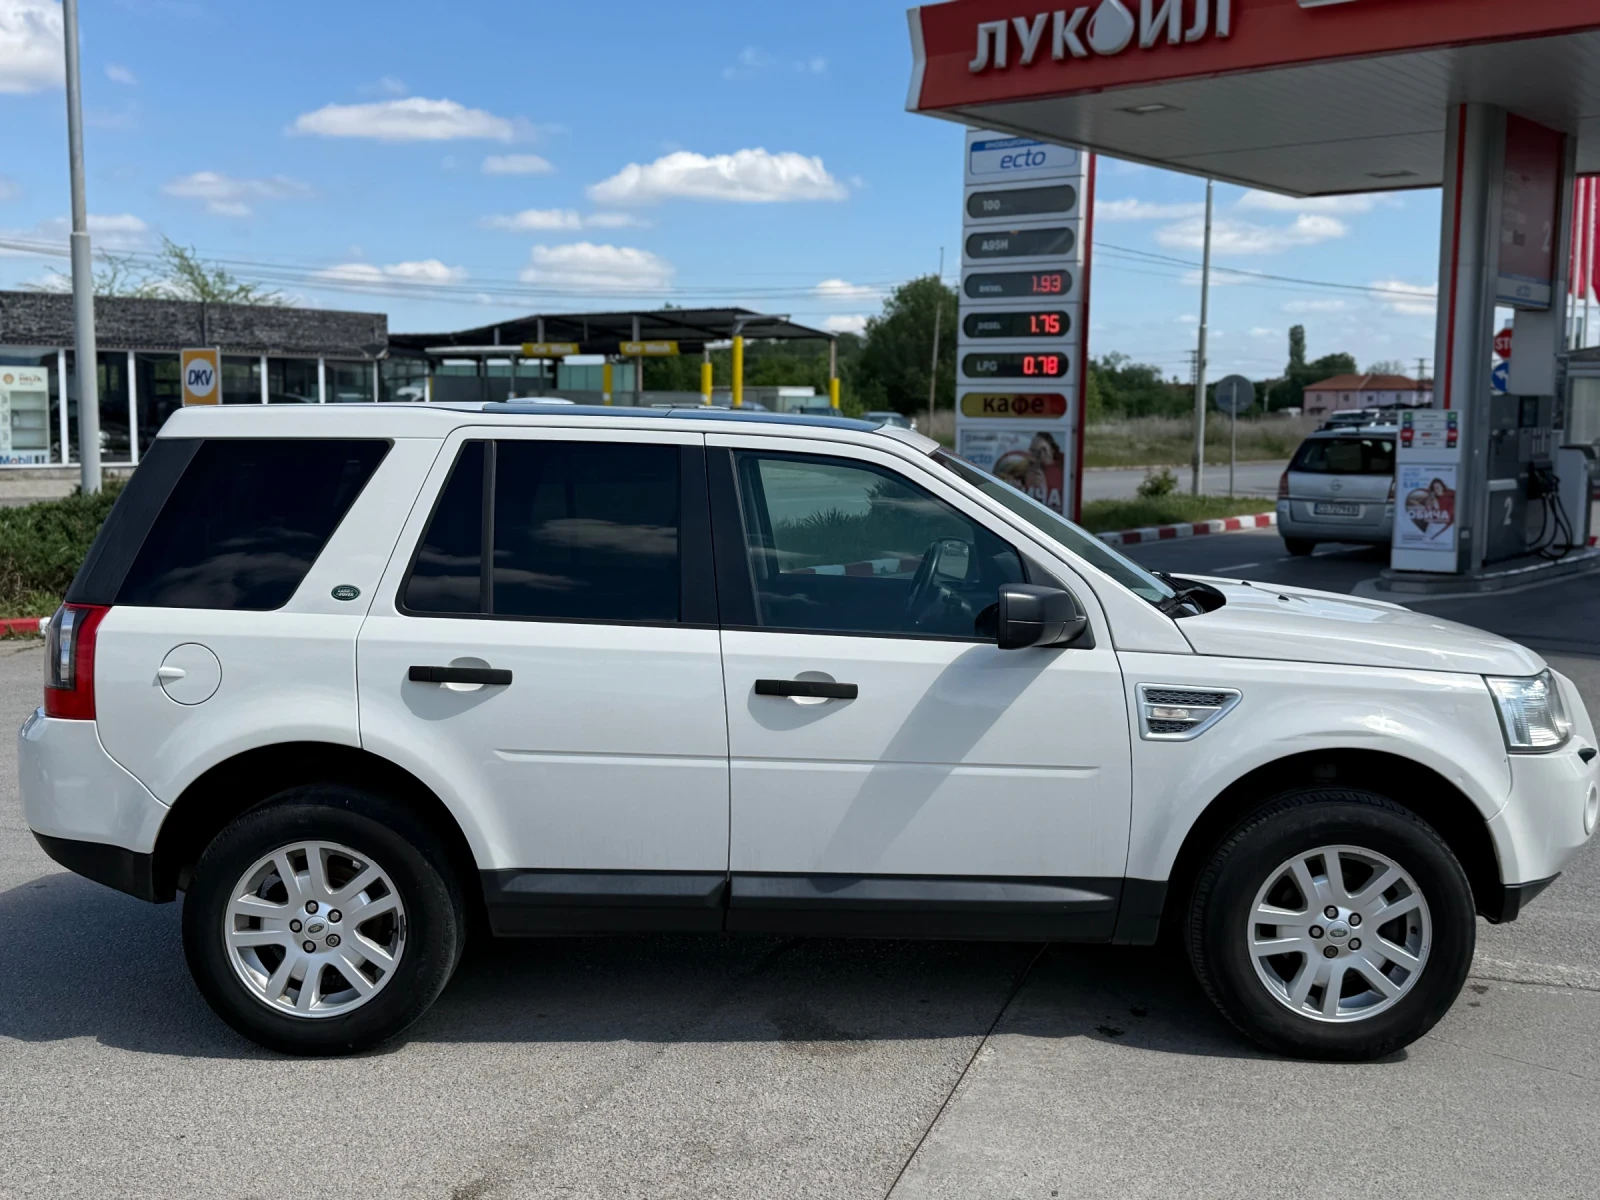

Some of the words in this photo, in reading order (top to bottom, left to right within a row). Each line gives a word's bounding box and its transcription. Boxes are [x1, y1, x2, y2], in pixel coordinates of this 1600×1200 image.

[1000, 148, 1046, 169] ecto
[982, 200, 1000, 211] 100
[1032, 275, 1062, 293] 1.93
[1030, 314, 1060, 334] 1.75
[976, 361, 998, 372] LPG
[1023, 356, 1059, 375] 0.78
[188, 369, 213, 386] DKV
[983, 397, 1045, 415] кафе
[1503, 497, 1513, 525] 2
